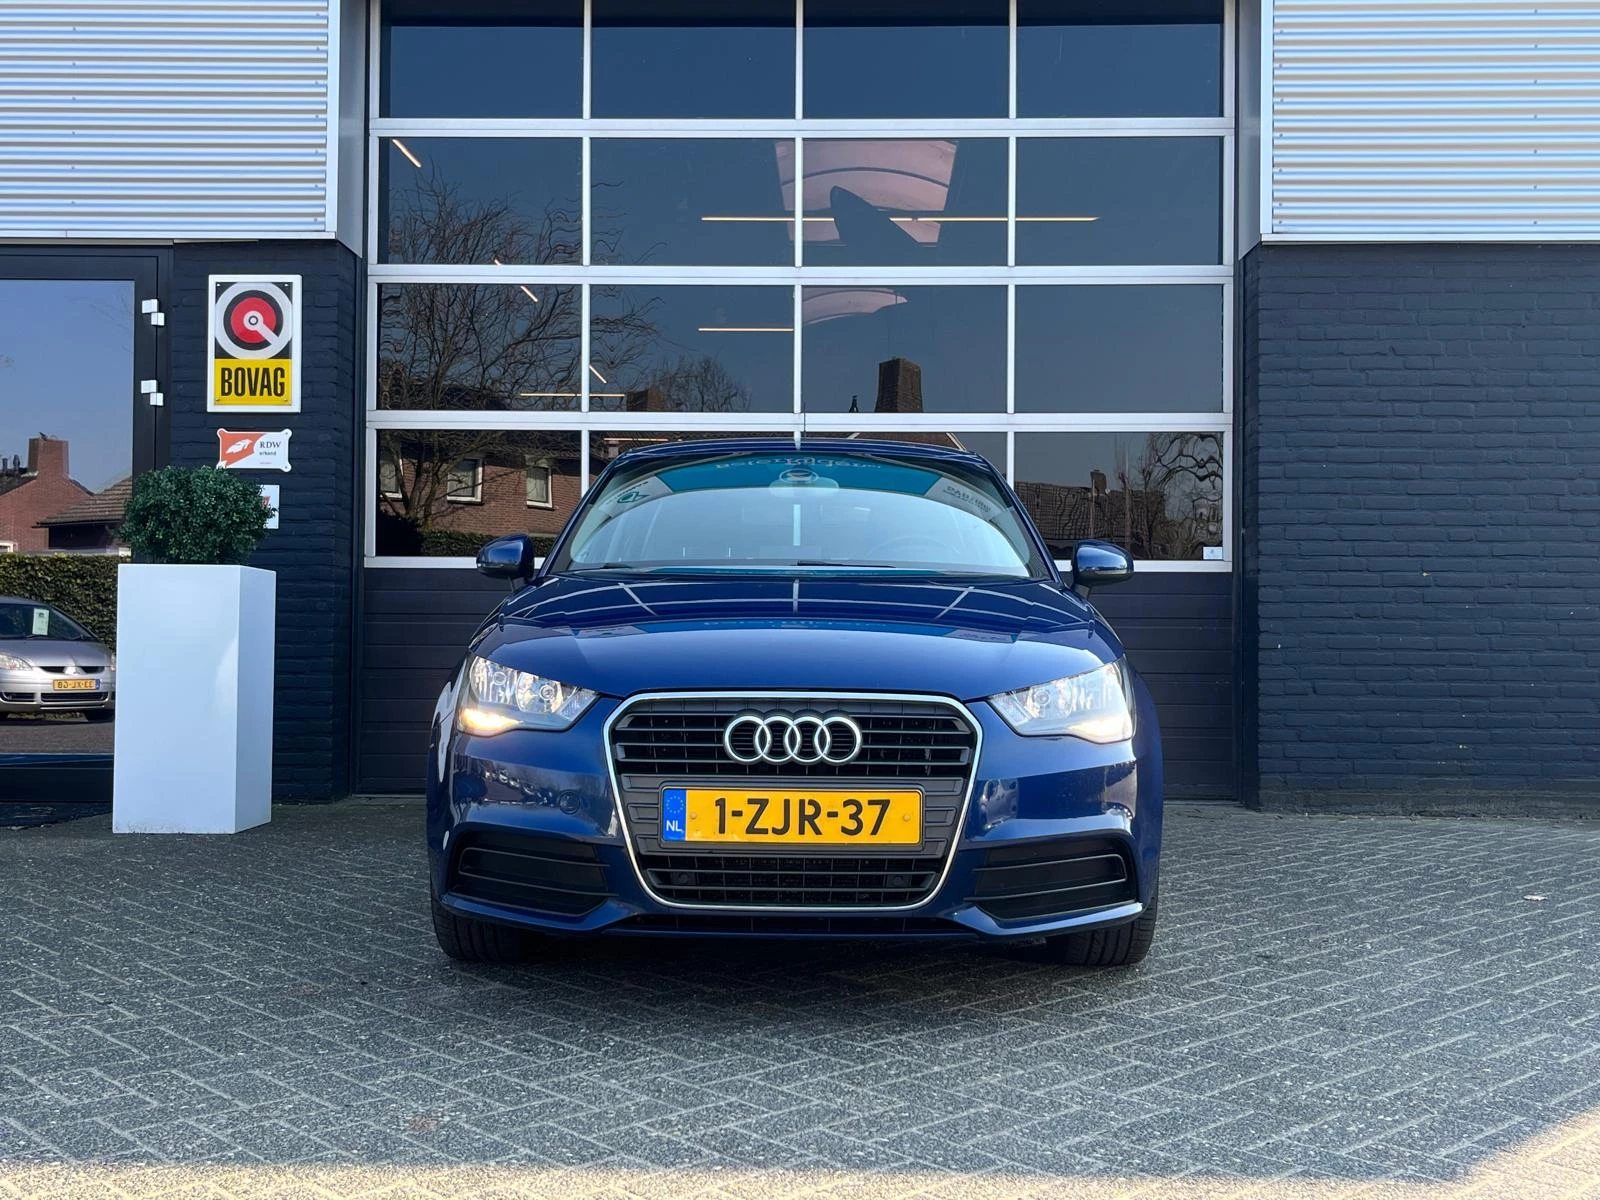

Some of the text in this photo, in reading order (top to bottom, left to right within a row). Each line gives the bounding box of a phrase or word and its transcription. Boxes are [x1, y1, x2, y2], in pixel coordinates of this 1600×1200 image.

[220, 367, 286, 397] BOVAG
[259, 441, 282, 449] RDW
[666, 819, 683, 832] NL
[714, 797, 891, 836] 1-ZJR-37
